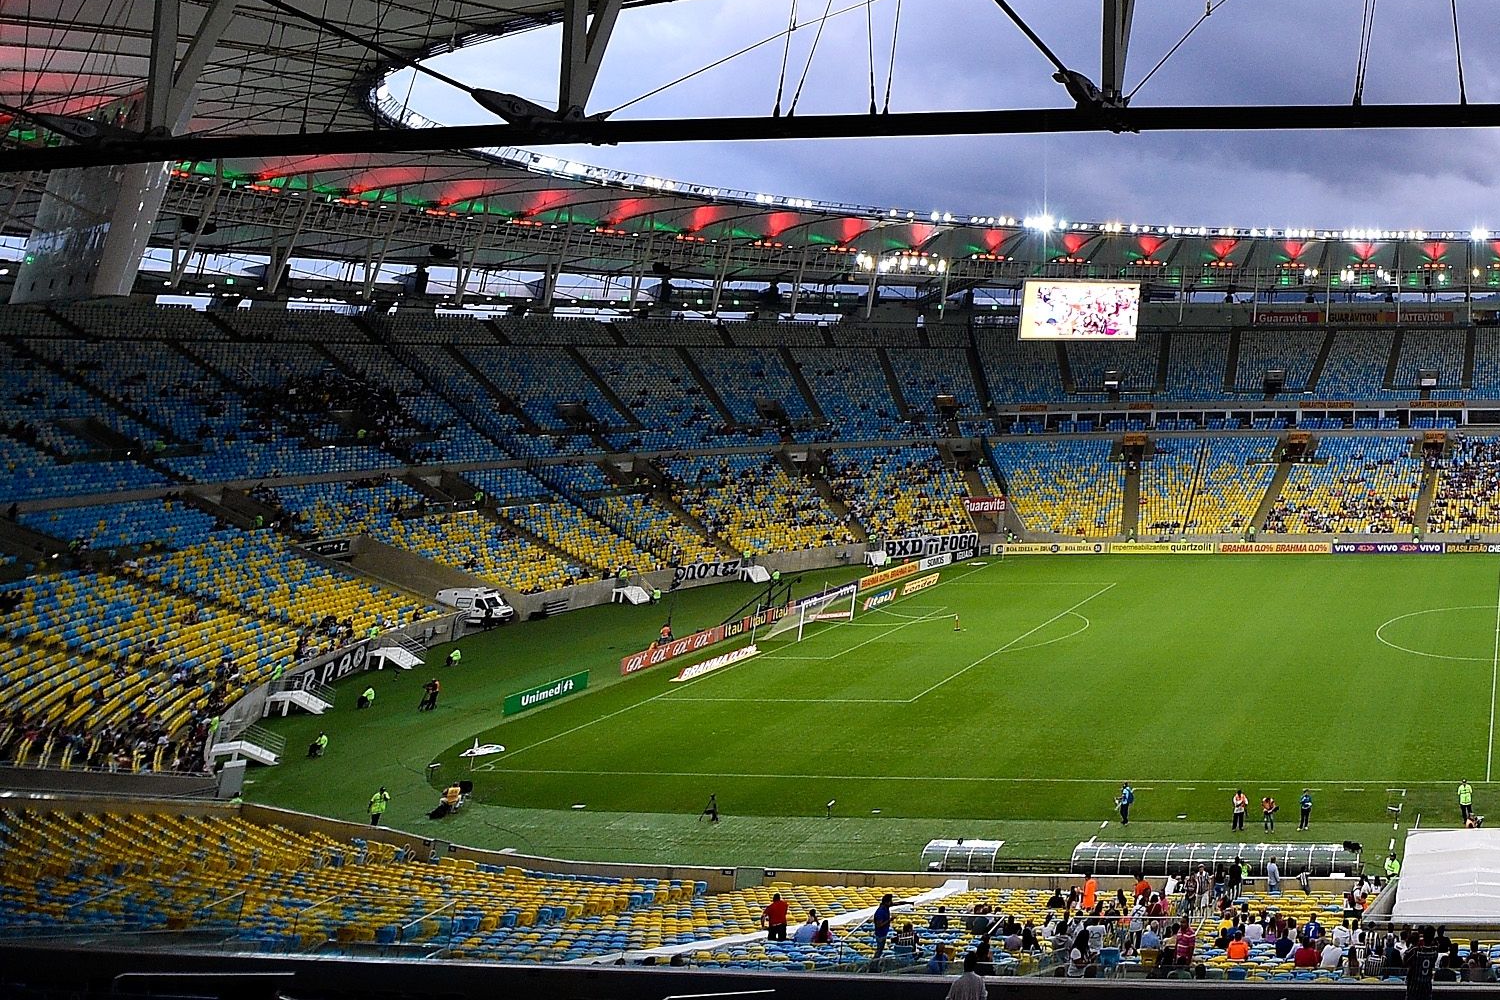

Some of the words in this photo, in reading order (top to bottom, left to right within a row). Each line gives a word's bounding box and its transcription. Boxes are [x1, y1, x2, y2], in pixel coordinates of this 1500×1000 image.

[1259, 314, 1308, 322] Guaravita
[941, 534, 977, 552] FOGO
[1170, 543, 1211, 552] quartzolit
[1222, 544, 1253, 552] BRAHMA
[1276, 544, 1307, 552] BRAHMA
[1447, 543, 1487, 552] BRASILEIRÃO
[928, 556, 945, 567] SOMOS
[904, 579, 937, 593] vonder
[725, 621, 743, 637] Itaú
[750, 612, 766, 628] Itaú
[772, 605, 788, 620] Itaú
[682, 653, 728, 678] BRAHMA
[521, 683, 561, 706] Unimed
[1309, 925, 1315, 937] 7
[1422, 959, 1430, 976] 9
